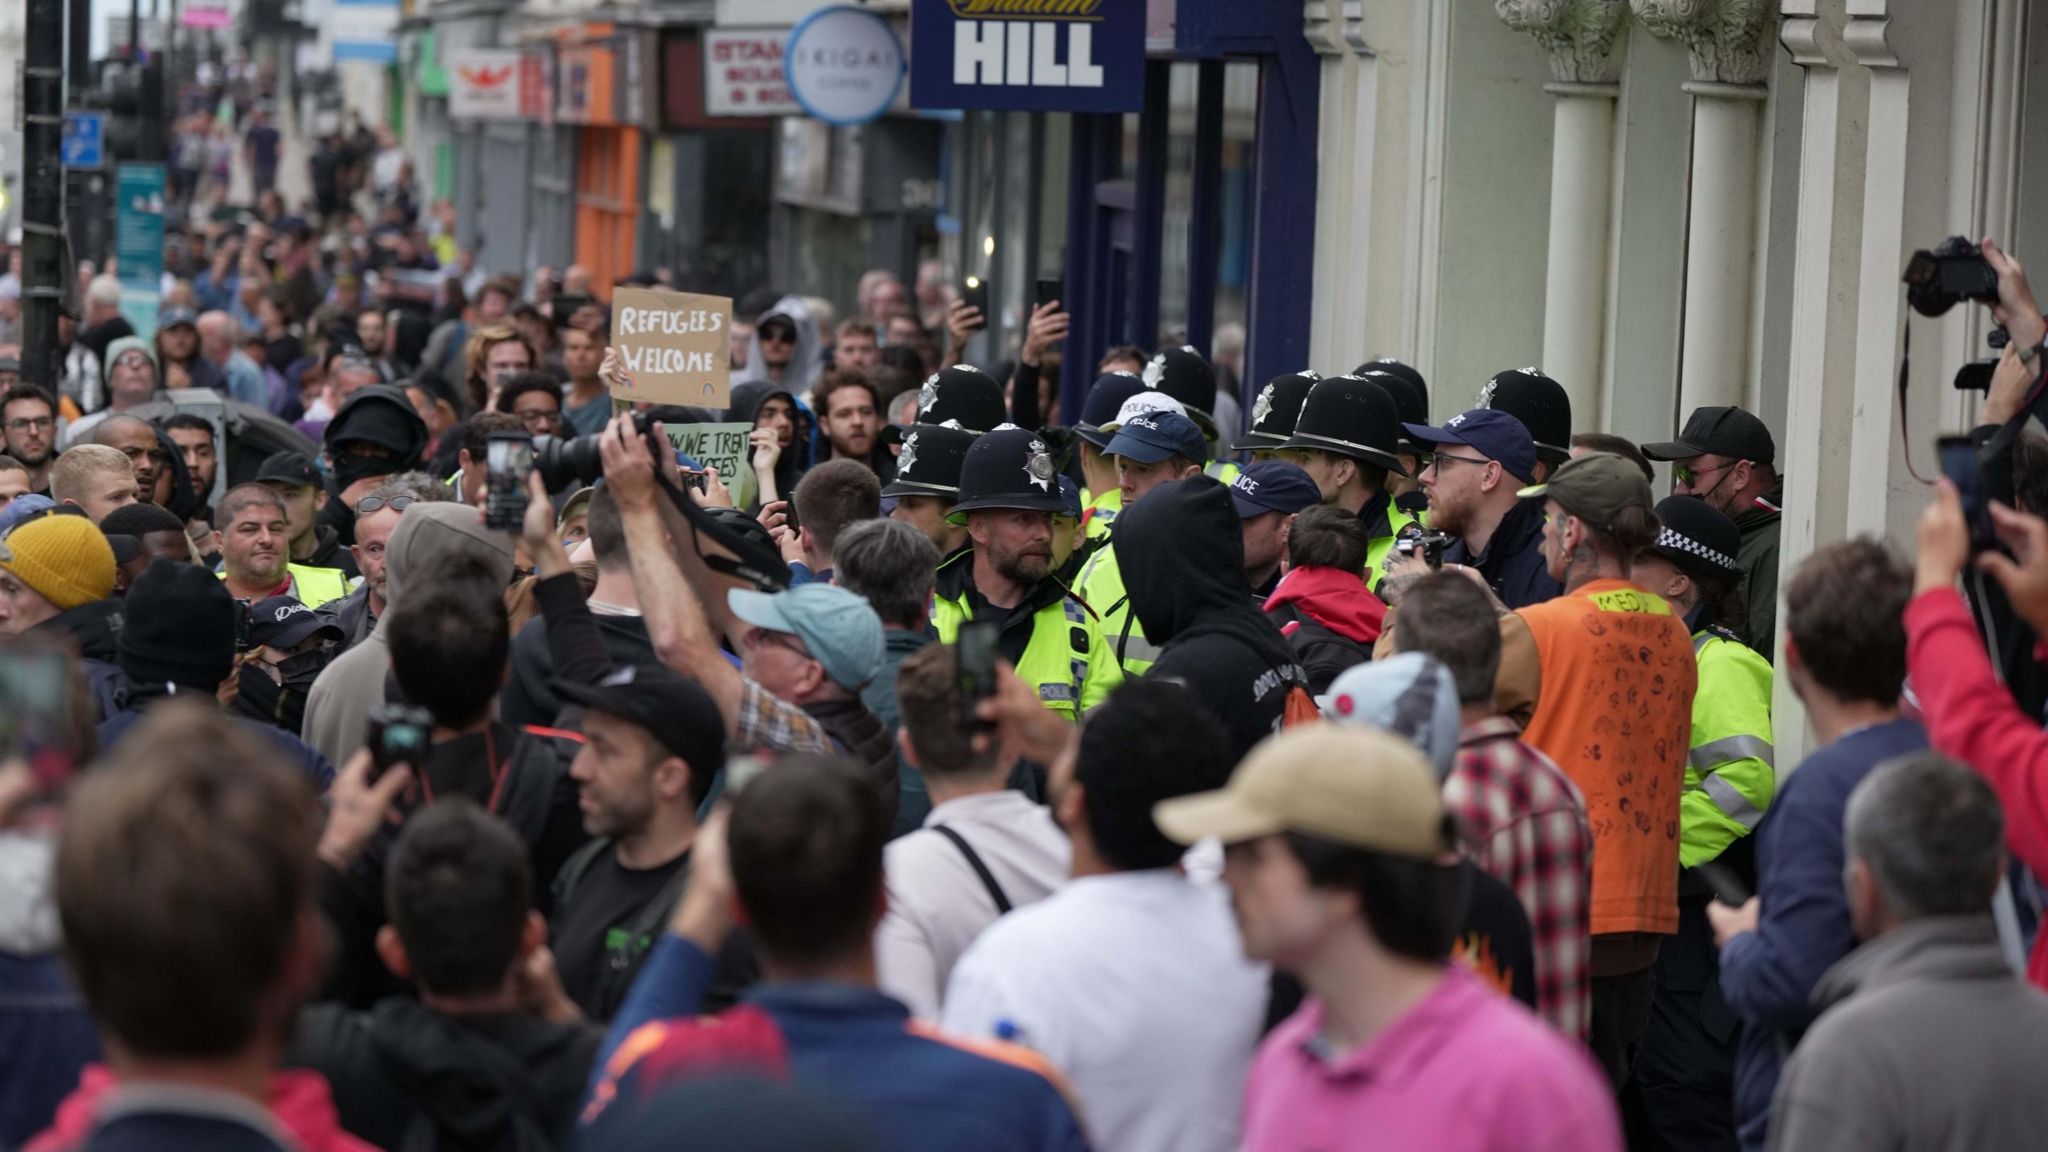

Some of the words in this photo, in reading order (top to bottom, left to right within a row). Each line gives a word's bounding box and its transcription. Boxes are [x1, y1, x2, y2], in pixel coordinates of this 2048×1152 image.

[953, 20, 1104, 87] HILL
[620, 307, 723, 335] REFUGEES
[620, 344, 712, 374] WELCOME
[1130, 418, 1158, 430] POLICE
[683, 432, 709, 455] WE
[714, 431, 751, 455] TREAT
